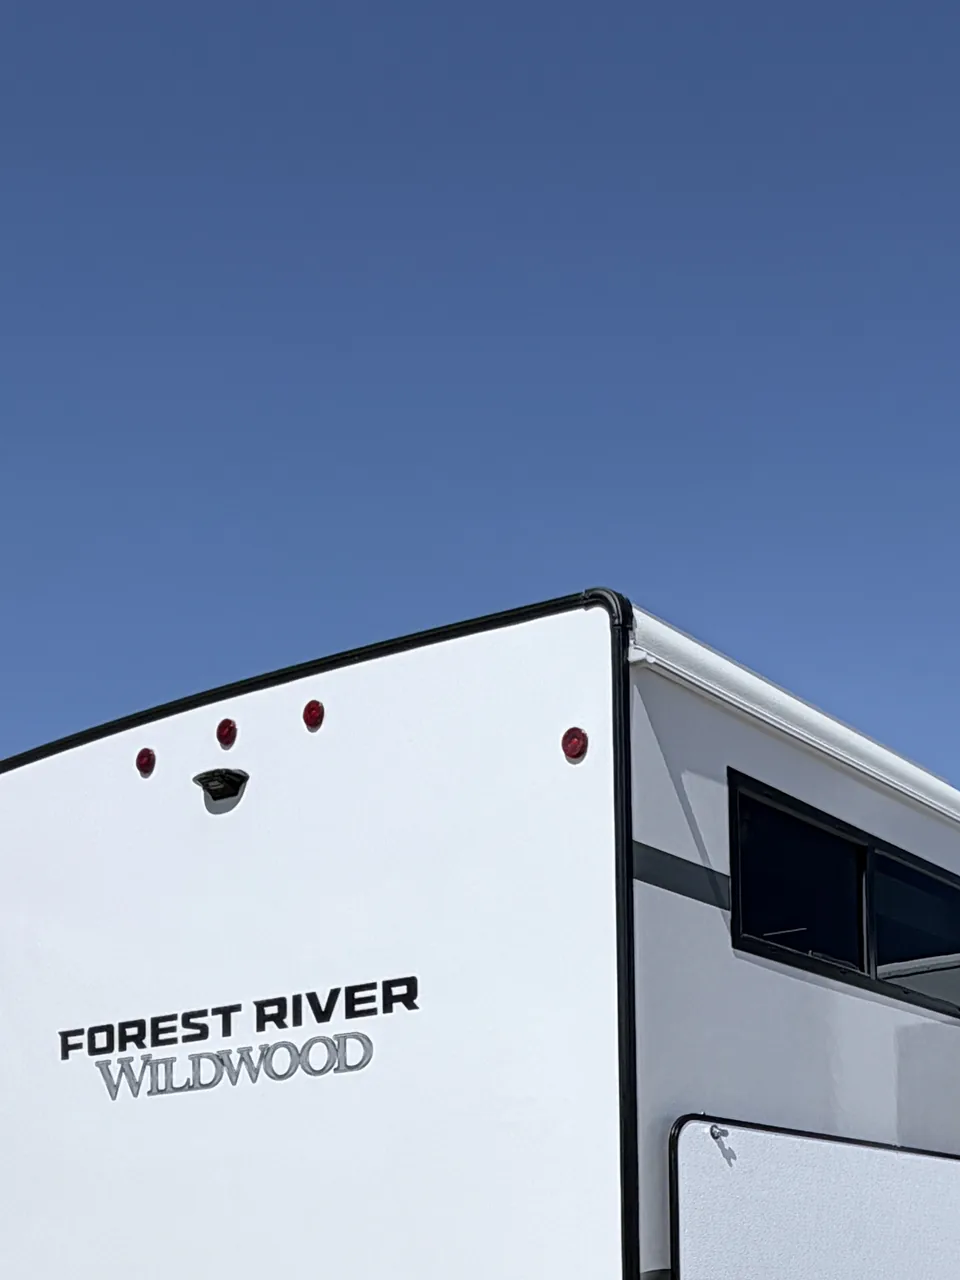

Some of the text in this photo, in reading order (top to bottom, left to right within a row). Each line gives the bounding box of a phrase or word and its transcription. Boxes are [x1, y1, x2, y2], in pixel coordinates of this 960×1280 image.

[58, 975, 420, 1060] FOREST RIVER
[95, 1031, 374, 1101] WILDWOOD
